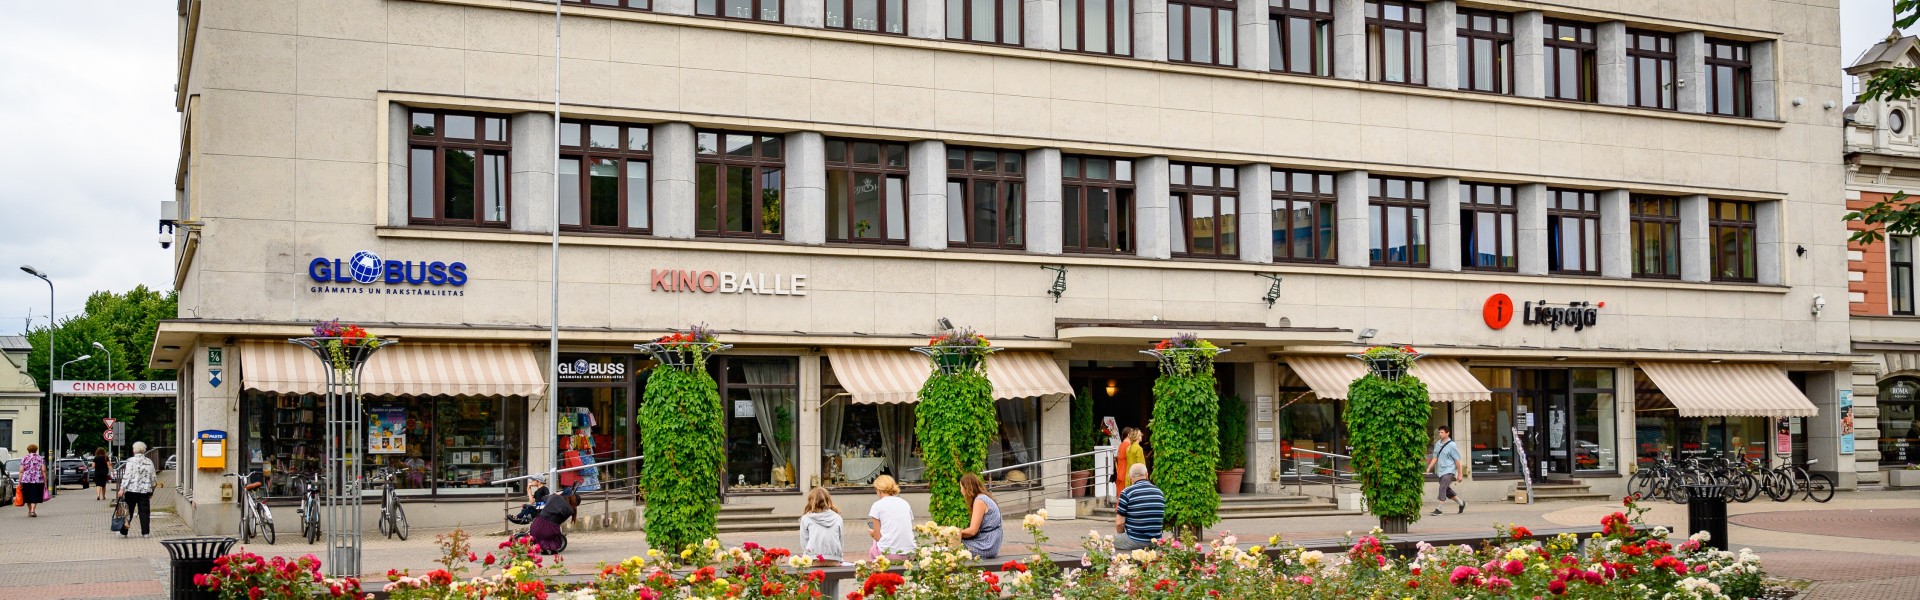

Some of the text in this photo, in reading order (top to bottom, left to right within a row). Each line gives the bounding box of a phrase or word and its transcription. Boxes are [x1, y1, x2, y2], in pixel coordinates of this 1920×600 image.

[309, 250, 468, 286] GLOBUSS
[310, 286, 364, 294] GRĀMATAS
[386, 288, 465, 297] RAKSTĀMLIETAS
[558, 359, 625, 374] GLOBUSS
[73, 382, 136, 391] CINAMON
[1892, 387, 1909, 395] ROMA
